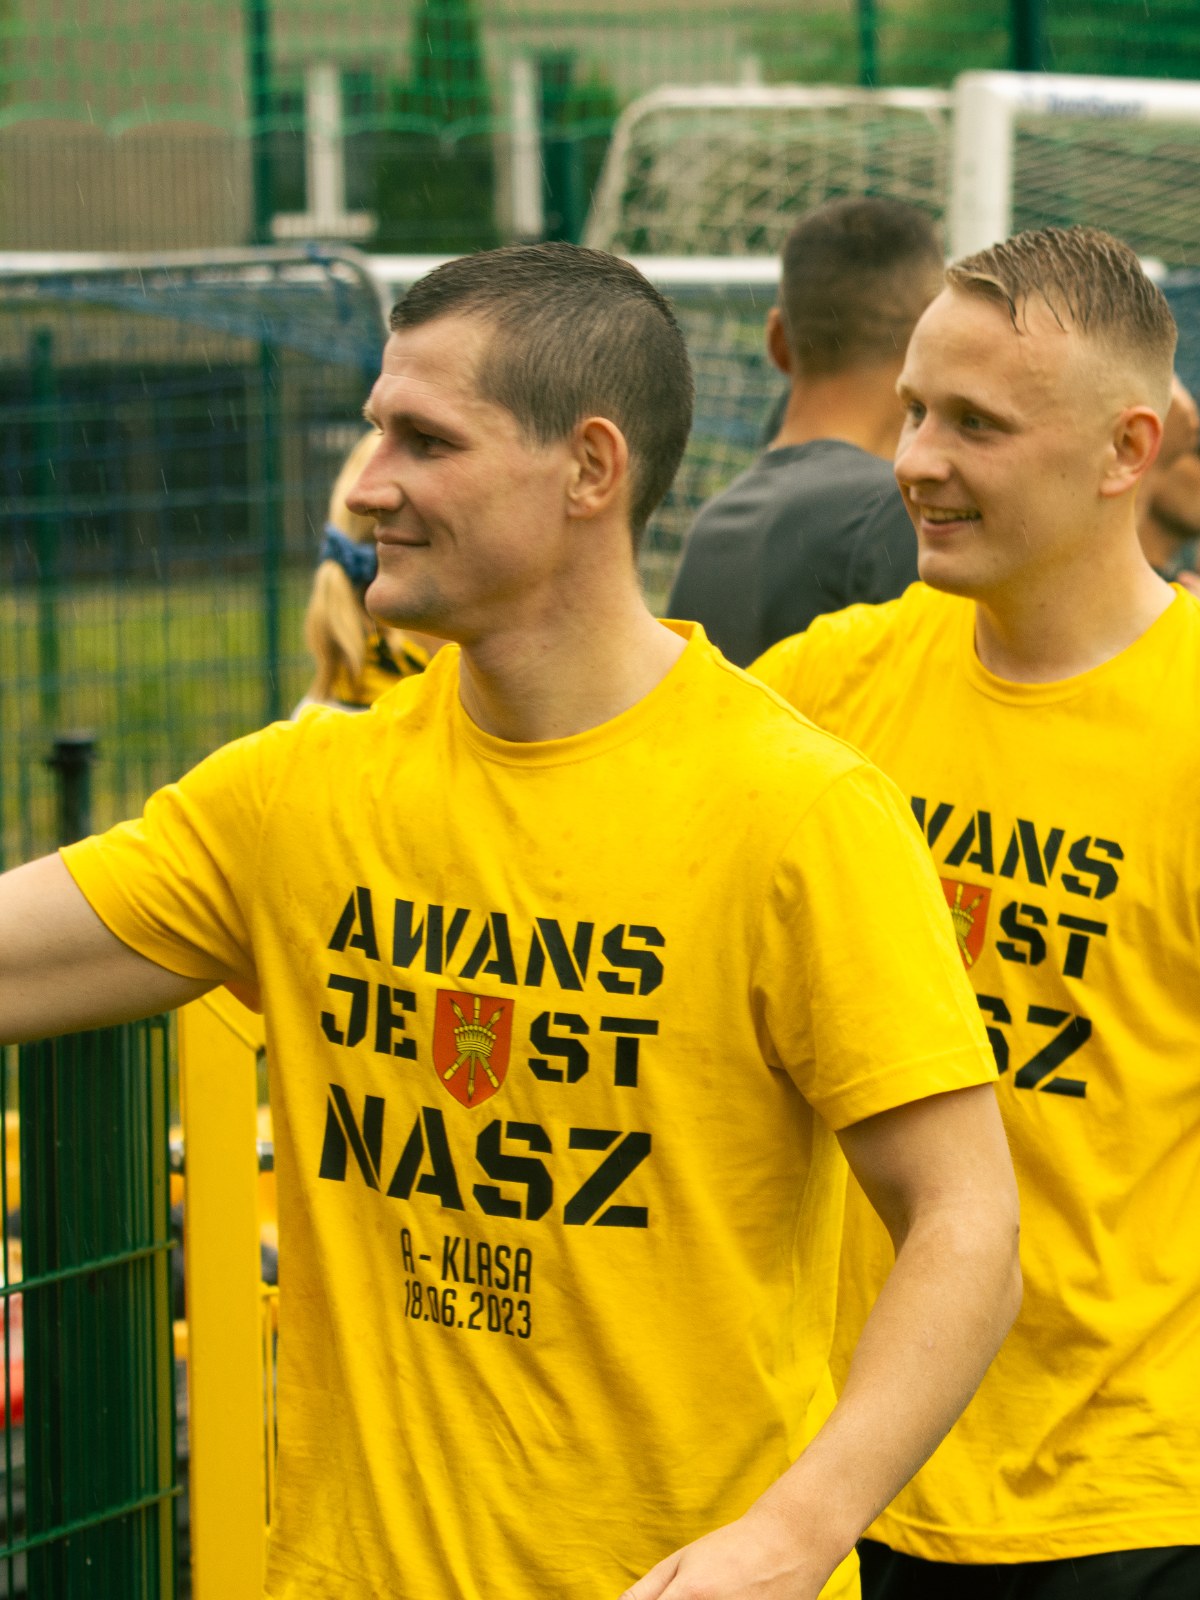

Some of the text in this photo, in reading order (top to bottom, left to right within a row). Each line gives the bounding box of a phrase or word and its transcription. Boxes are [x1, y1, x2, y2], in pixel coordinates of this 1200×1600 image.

[911, 796, 1124, 900] ANS
[328, 886, 665, 996] AWANS
[996, 901, 1108, 980] ST
[321, 973, 659, 1088] JE ST
[318, 1083, 652, 1229] NASZ
[404, 1280, 532, 1339] 18.06.2023
[441, 1235, 532, 1294] KLASA
